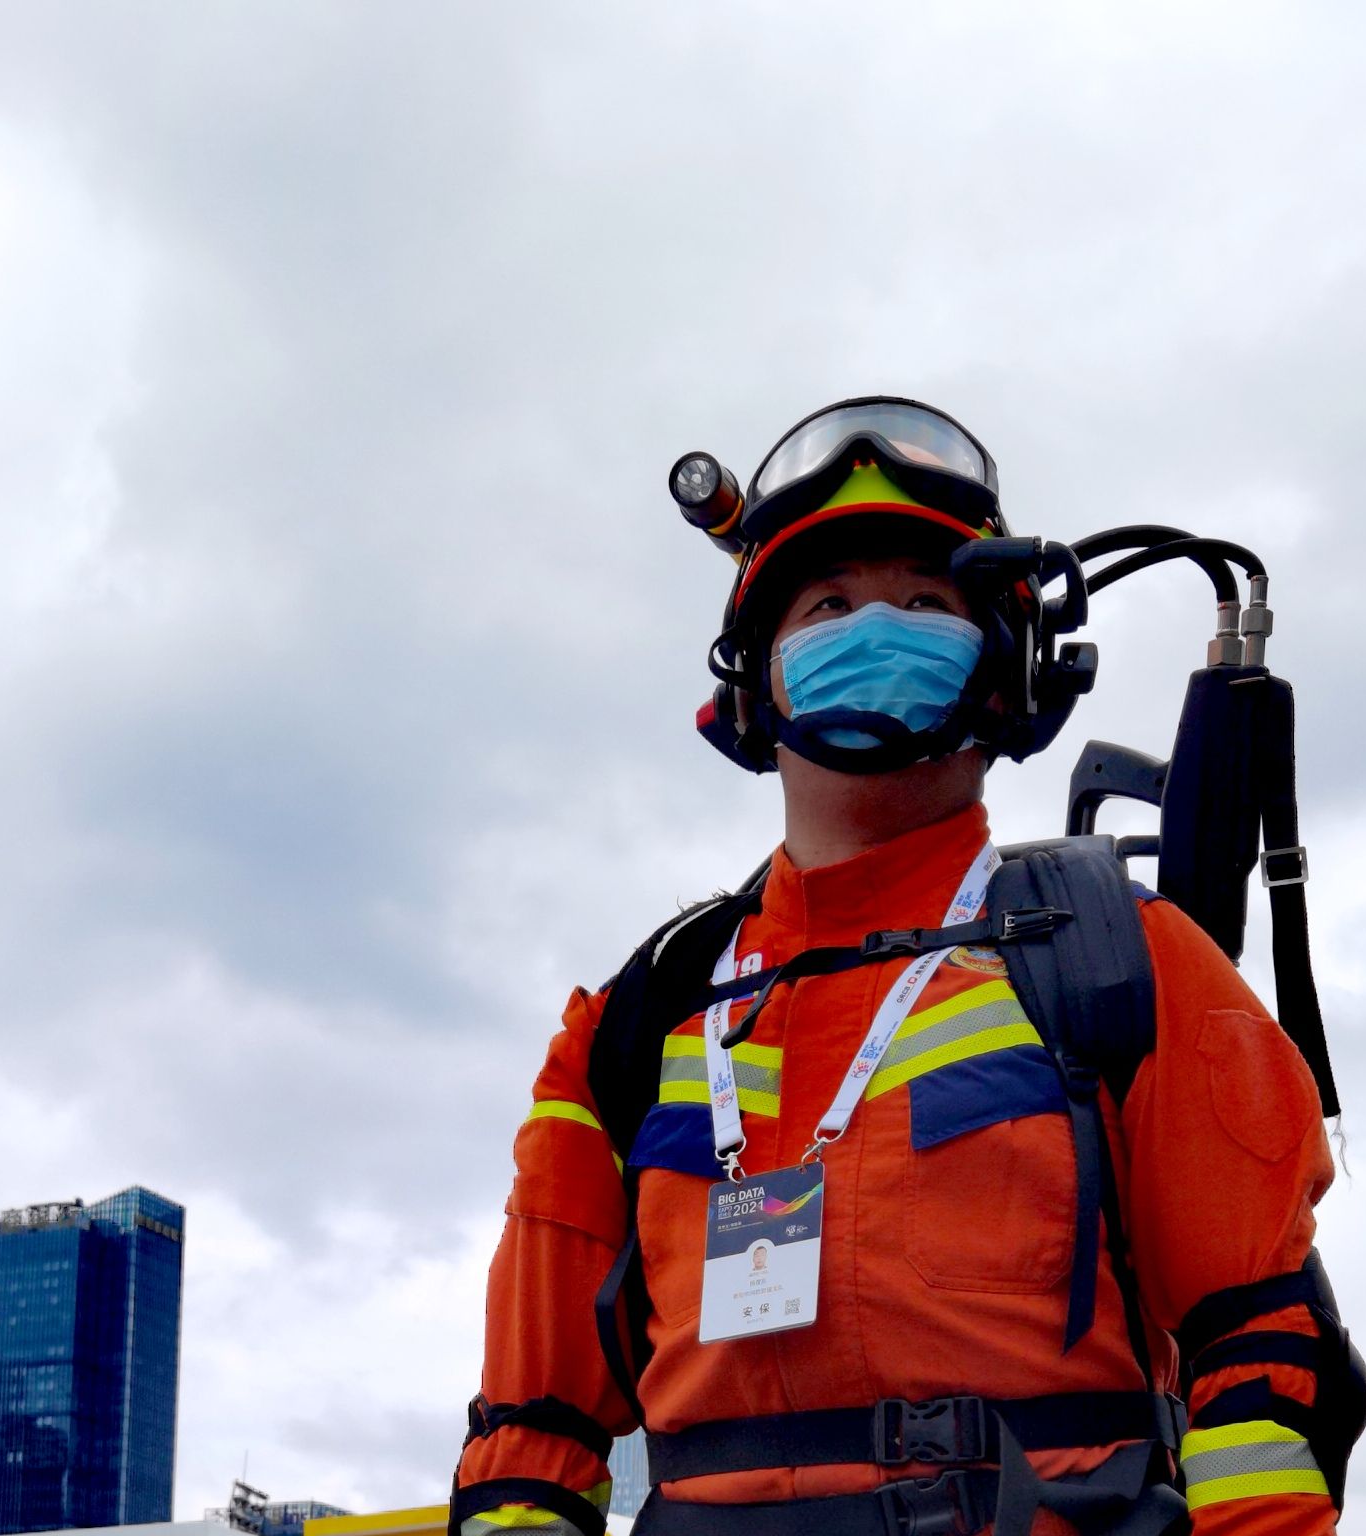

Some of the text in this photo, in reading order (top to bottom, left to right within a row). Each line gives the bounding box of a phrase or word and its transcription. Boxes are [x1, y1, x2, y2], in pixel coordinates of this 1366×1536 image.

[718, 1186, 765, 1205] BIG DATA
[733, 1199, 764, 1217] 2021
